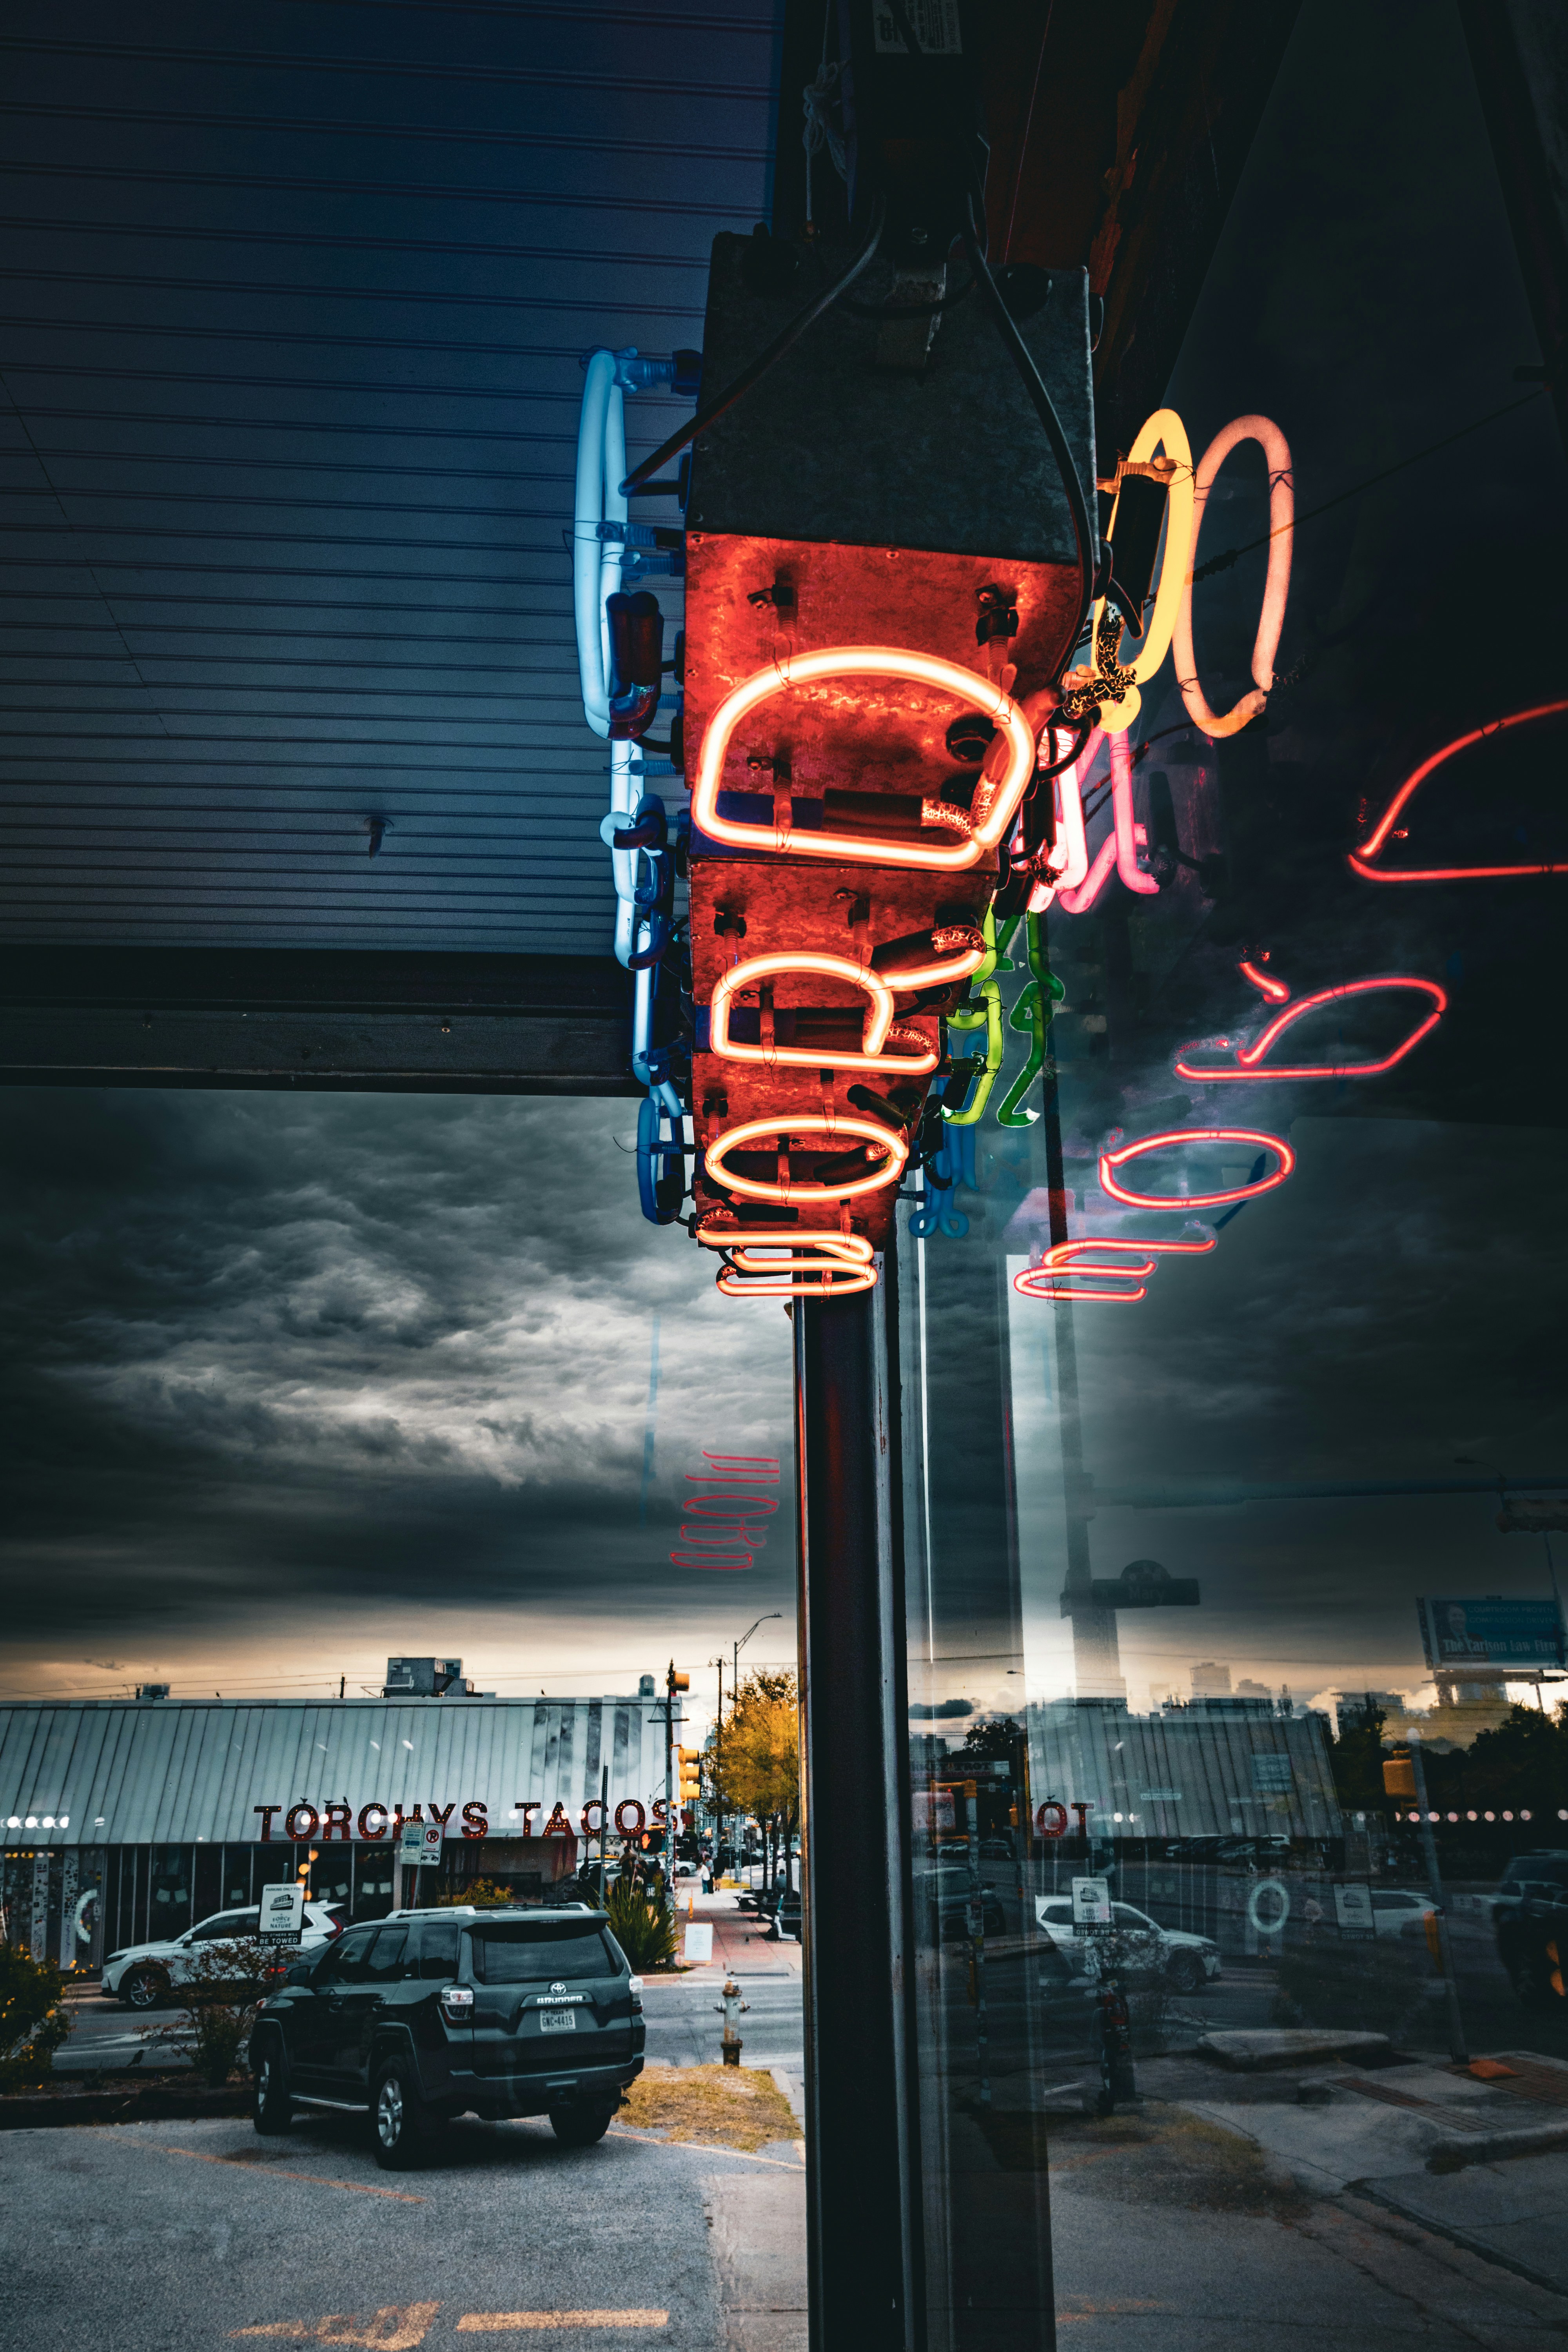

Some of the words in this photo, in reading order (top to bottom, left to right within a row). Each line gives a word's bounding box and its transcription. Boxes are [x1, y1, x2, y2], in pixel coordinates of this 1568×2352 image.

[1128, 1586, 1165, 1604] Mary
[1443, 1639, 1464, 1652] The
[1466, 1639, 1507, 1652] Carlson
[1509, 1639, 1531, 1652] Law
[254, 1802, 488, 1842] TORCHYS
[515, 1798, 678, 1837] TACOS
